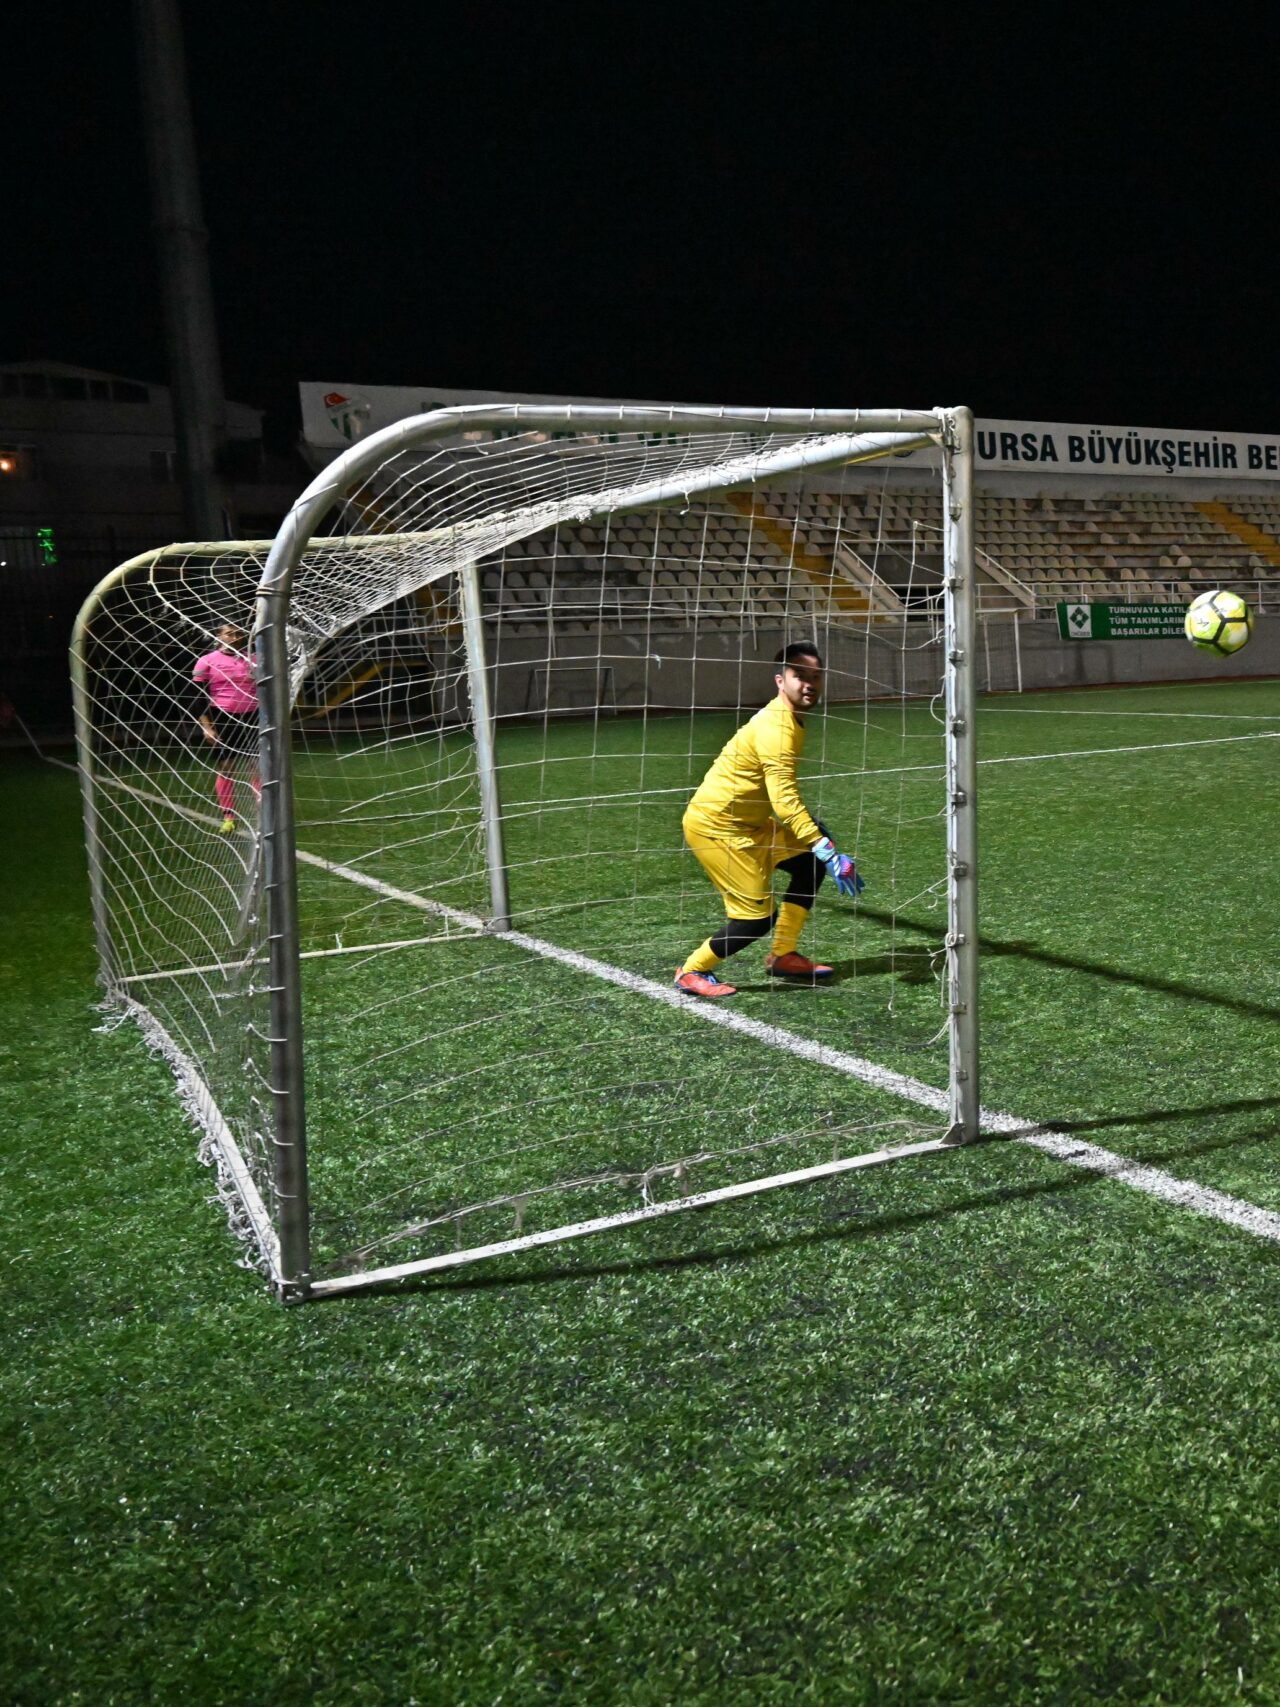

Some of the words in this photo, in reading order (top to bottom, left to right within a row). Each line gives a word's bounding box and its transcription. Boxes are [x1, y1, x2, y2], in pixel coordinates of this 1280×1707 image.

[977, 431, 1058, 462] URSA
[1068, 429, 1237, 473] BÜYÜKŞEHİR
[1108, 606, 1160, 614] TURNUVAYA
[1109, 615, 1128, 624] TÜM
[1130, 616, 1185, 624] TAKIMLARIM
[1111, 627, 1160, 636] BAŞARILAR
[1162, 626, 1186, 635] DİLER
